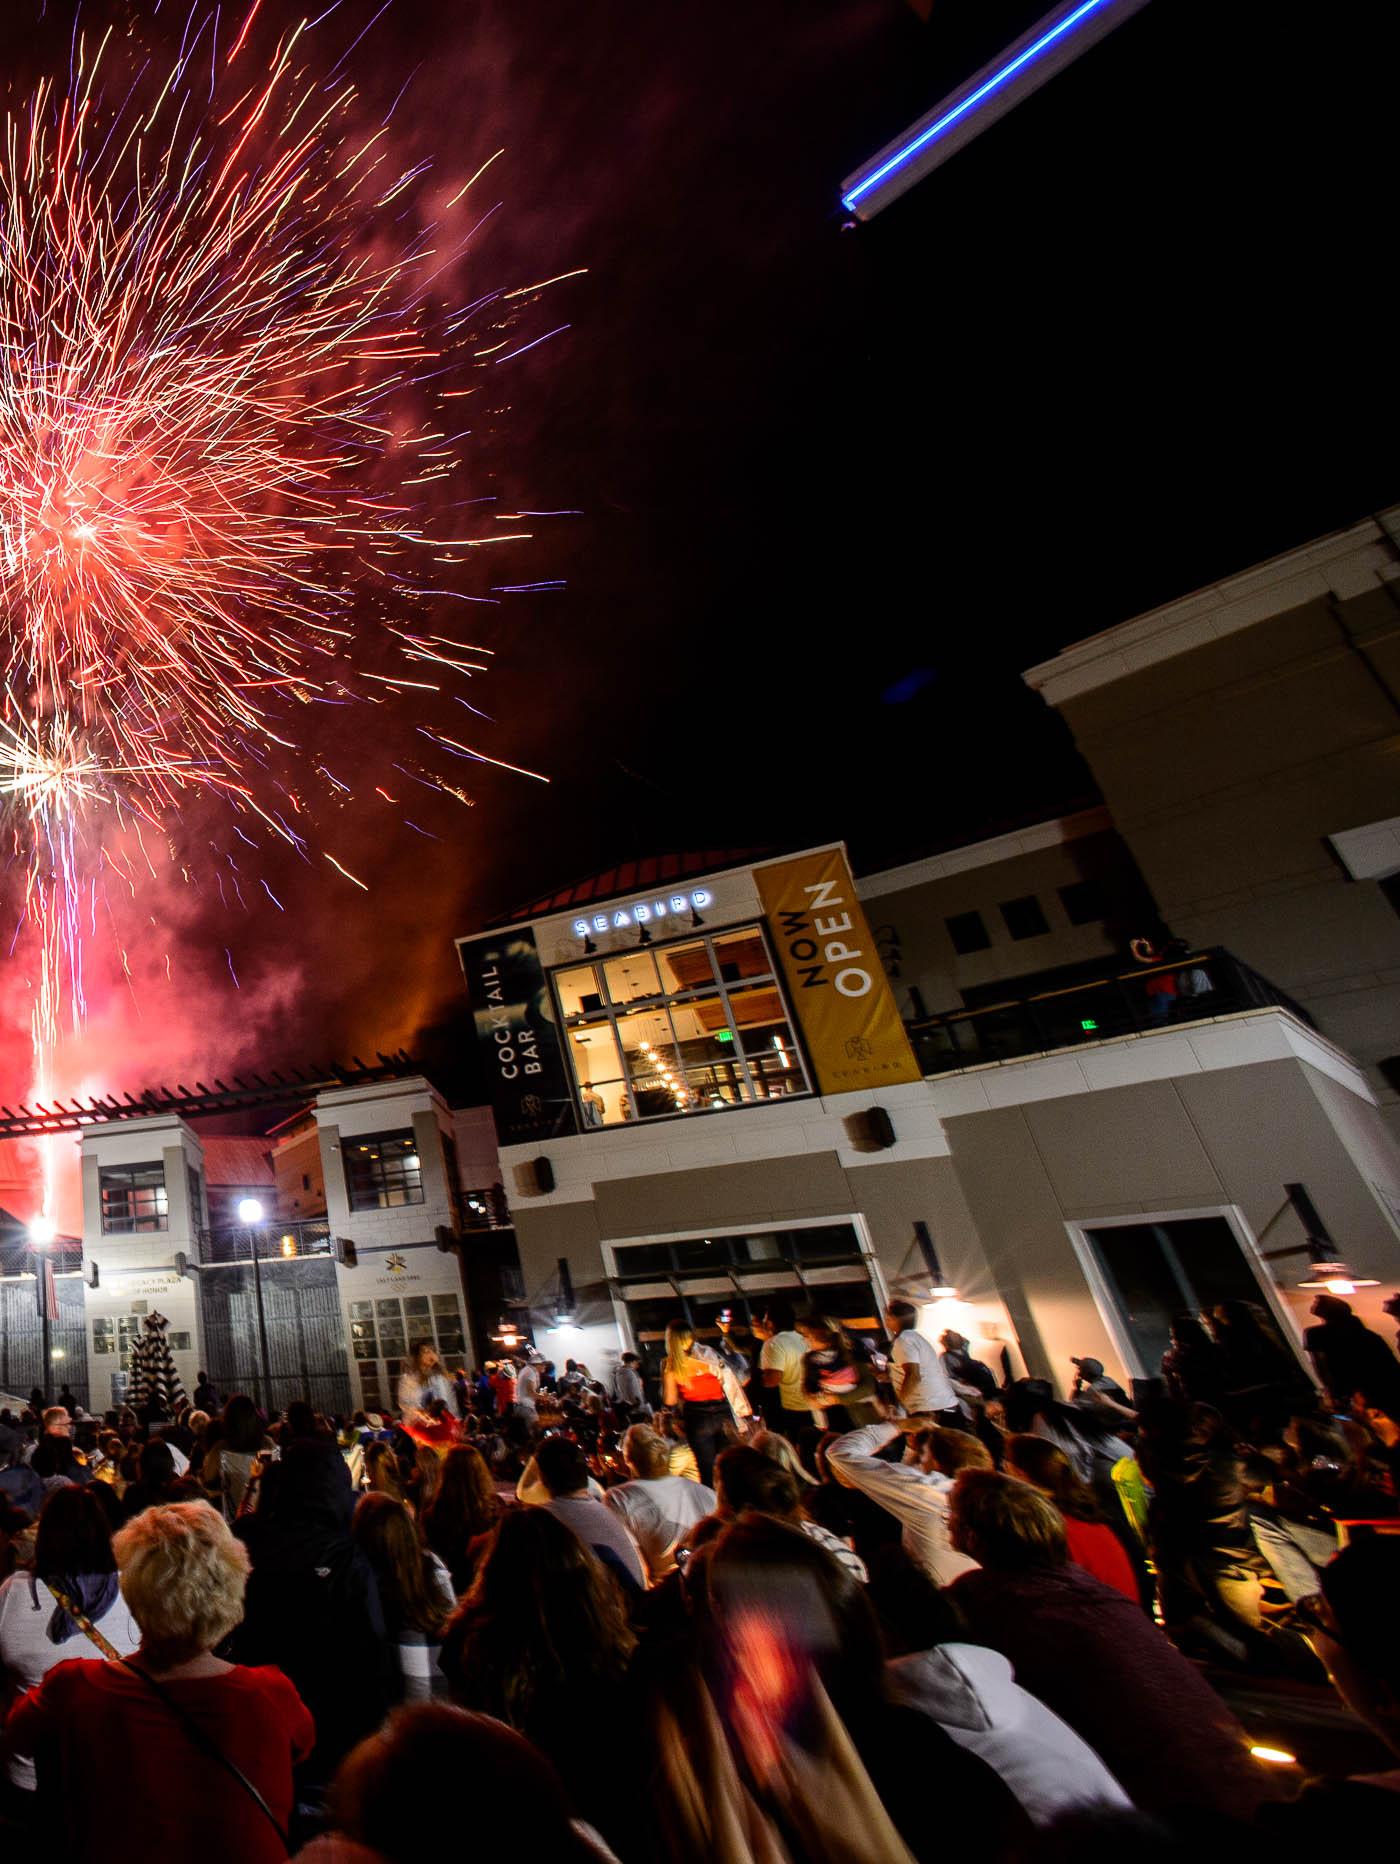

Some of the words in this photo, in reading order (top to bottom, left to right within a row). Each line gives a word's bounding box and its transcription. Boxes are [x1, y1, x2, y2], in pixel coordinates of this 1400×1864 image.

[575, 891, 710, 936] SEABIRD
[779, 911, 829, 987] NOW
[803, 880, 872, 997] OPEN
[482, 966, 518, 1079] COCKTAIL
[518, 1030, 543, 1075] BAR
